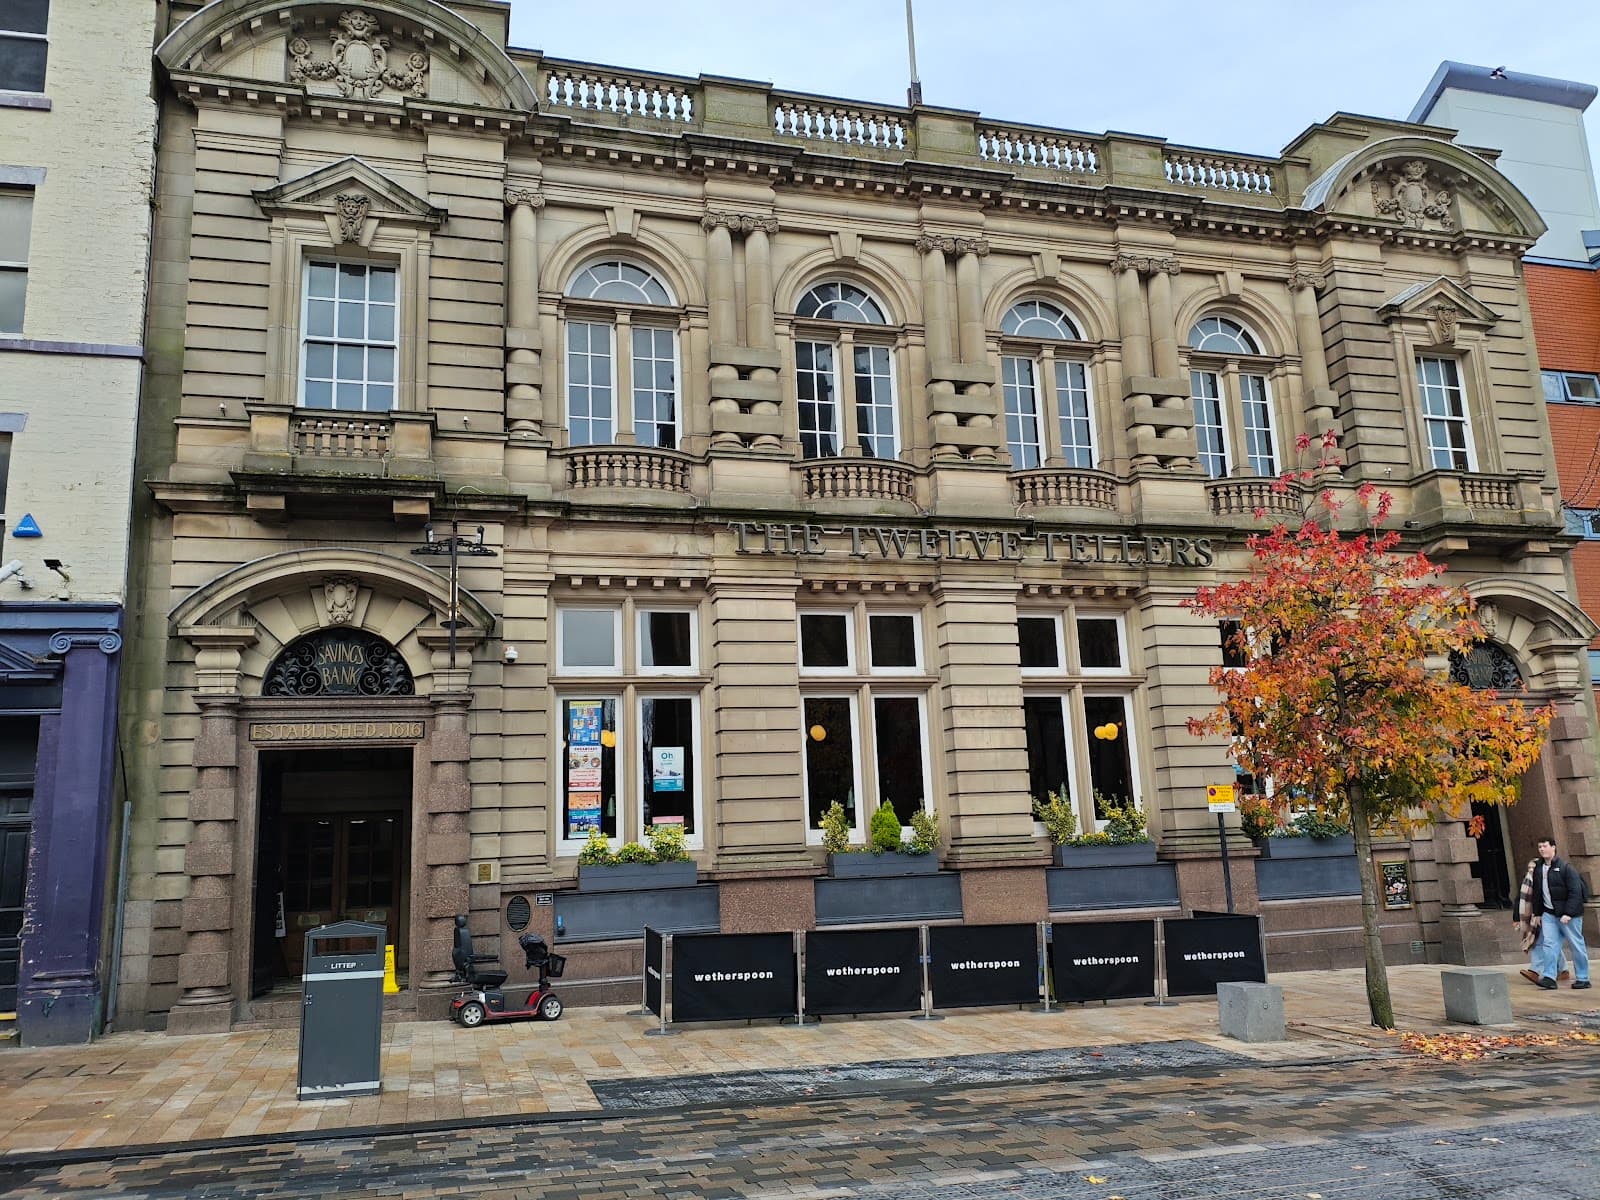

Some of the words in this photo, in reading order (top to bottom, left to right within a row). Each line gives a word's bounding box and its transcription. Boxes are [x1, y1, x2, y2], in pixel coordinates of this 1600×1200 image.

[728, 521, 827, 555] THE
[841, 525, 1025, 561] TWELVE
[1036, 531, 1213, 567] TELLERS
[318, 643, 365, 665] SAVINGS
[322, 666, 361, 686] BANK
[389, 722, 422, 738] 1816
[1073, 955, 1139, 966] wetherspoon
[1184, 949, 1245, 961] wetherspoon
[951, 959, 1020, 970] wetherspoon
[694, 970, 773, 982] wetherspoon
[826, 965, 900, 977] wetherspoon
